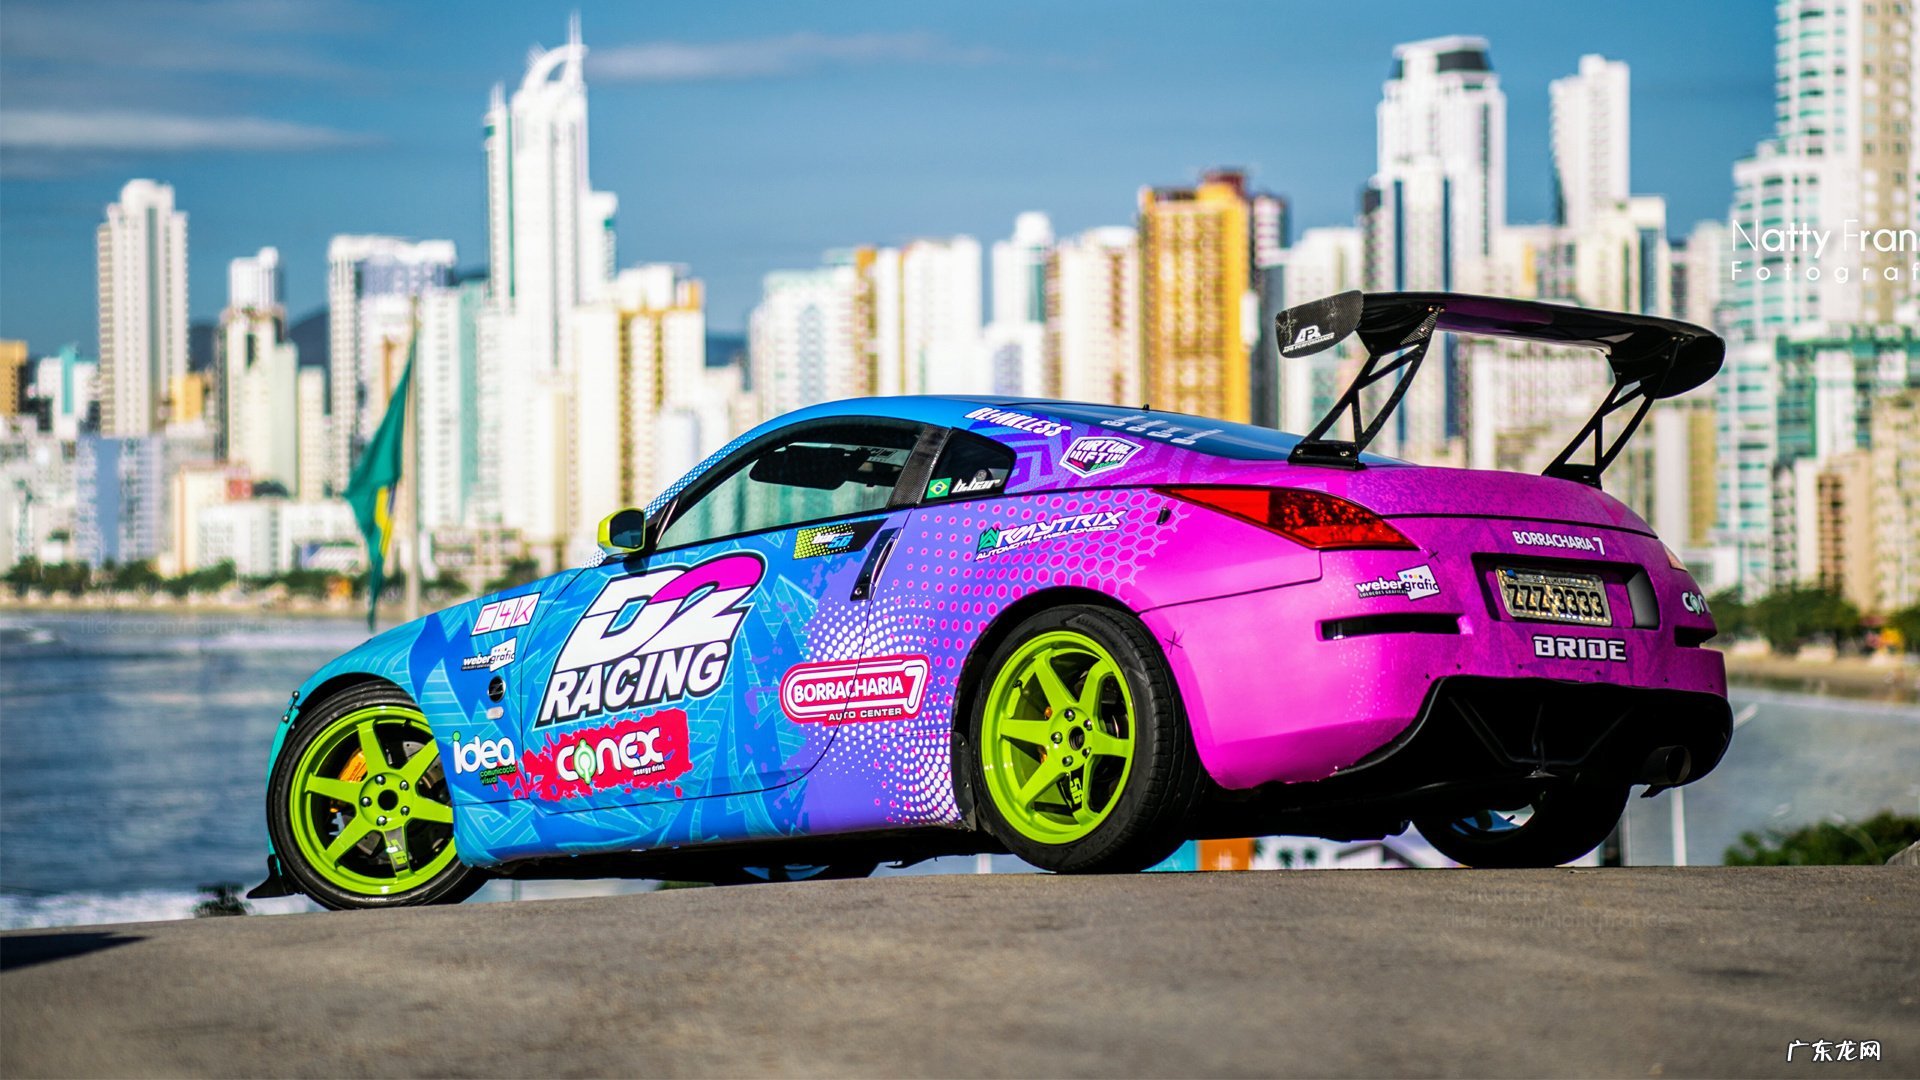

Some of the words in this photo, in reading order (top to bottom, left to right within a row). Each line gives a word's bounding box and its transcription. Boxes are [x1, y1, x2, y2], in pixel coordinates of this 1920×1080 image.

[975, 535, 1042, 560] AUTOMOTIVE
[1043, 525, 1118, 541] WEAPONIZED
[1512, 531, 1596, 551] BORRACHARIA
[1592, 536, 1605, 555] 7
[555, 555, 764, 673] D2
[1532, 635, 1627, 661] BRIDE
[538, 641, 730, 724] RACING
[793, 675, 904, 703] BORRACHARIA
[904, 665, 924, 709] 7
[828, 711, 856, 721] AUTO
[860, 708, 902, 718] CENTER
[452, 731, 516, 774] idea
[633, 766, 652, 776] energy
[651, 762, 666, 773] drink
